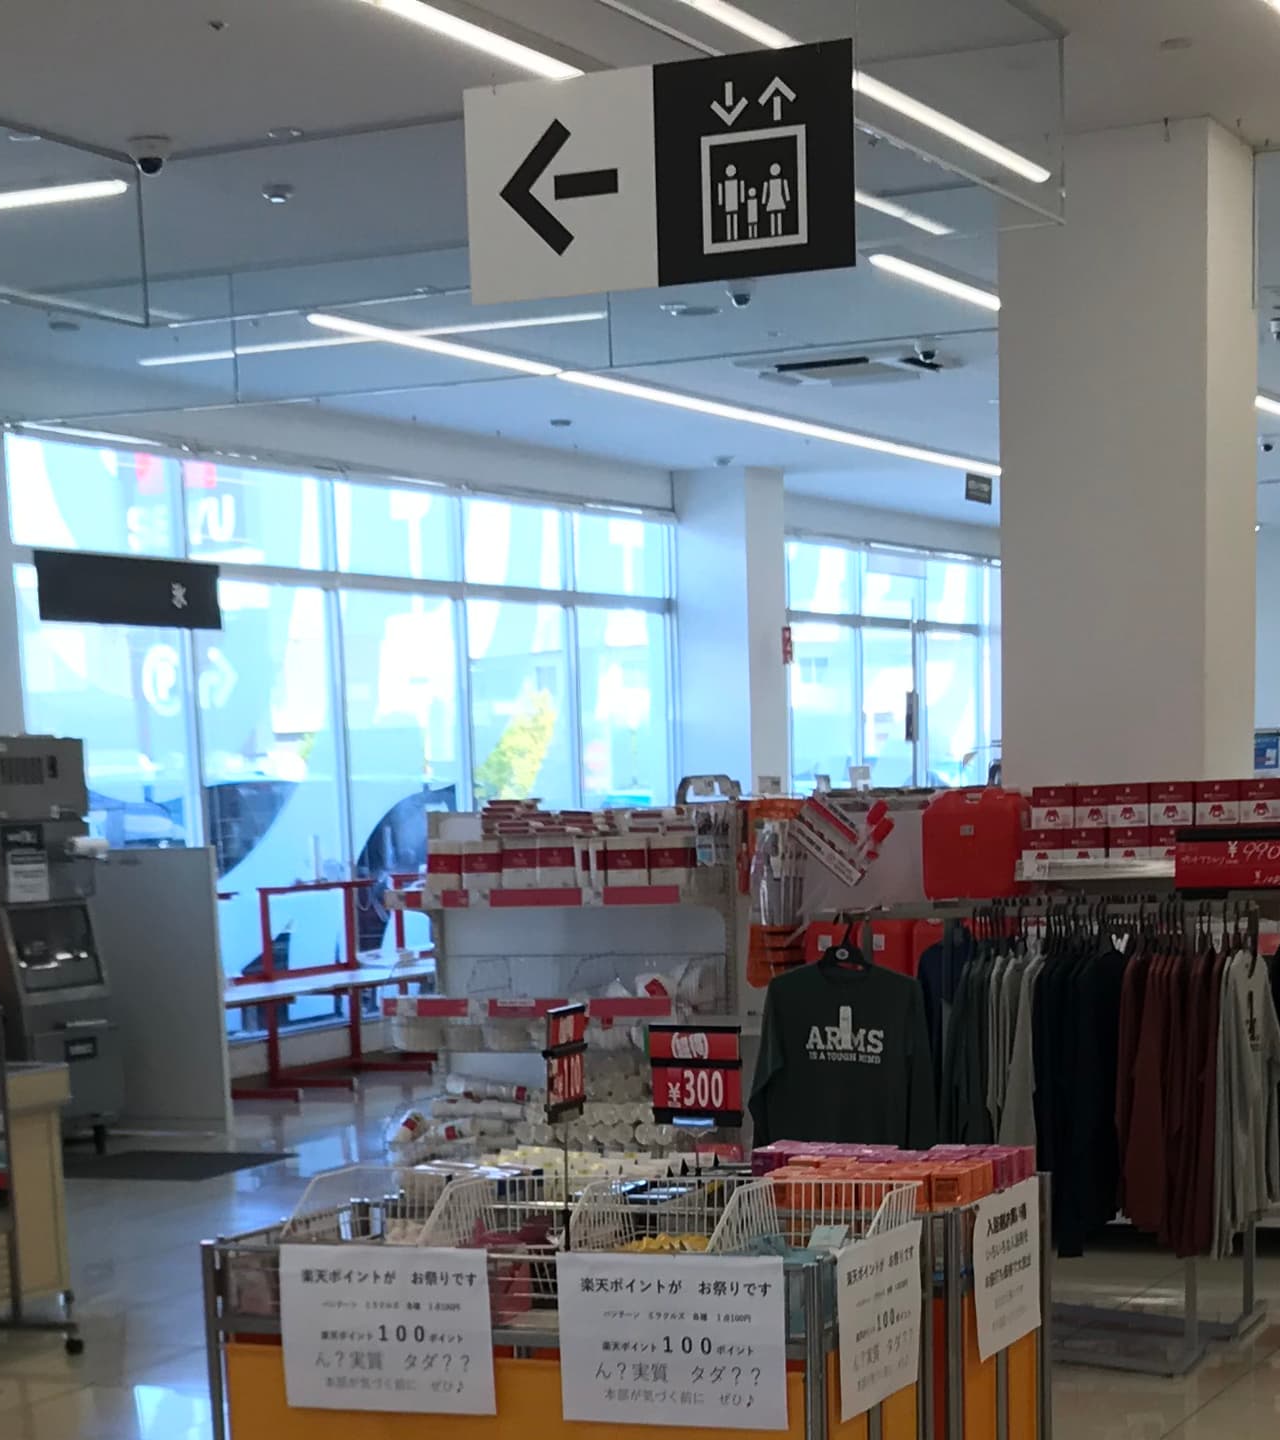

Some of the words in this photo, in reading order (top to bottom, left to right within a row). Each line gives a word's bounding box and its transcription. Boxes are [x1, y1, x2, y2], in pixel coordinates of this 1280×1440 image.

[806, 1025, 884, 1054] ARMS
[668, 1070, 724, 1108] ¥300
[301, 1269, 396, 1284] 楽天ポイントが
[411, 1271, 477, 1286] お祭りです
[580, 1277, 682, 1294] 楽天ポイントが
[698, 1281, 771, 1297] お祭りです
[595, 1362, 668, 1382] ん？実質
[691, 1365, 761, 1386] タダ？？
